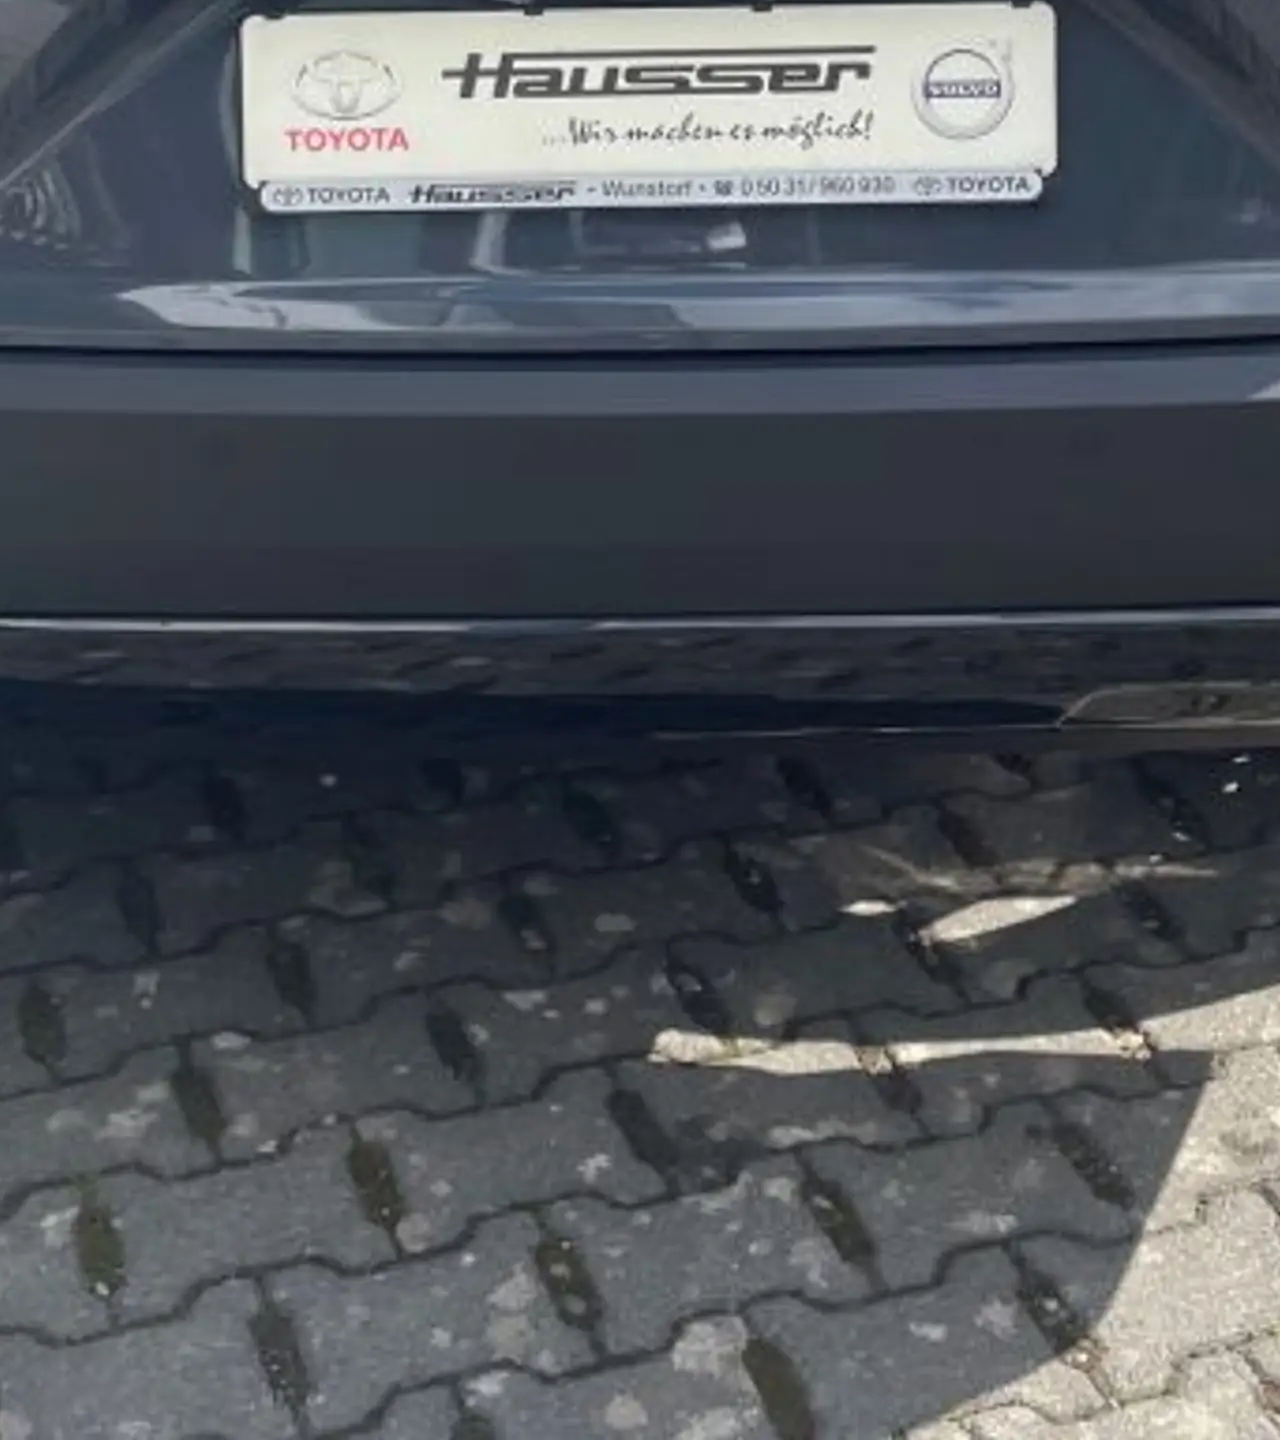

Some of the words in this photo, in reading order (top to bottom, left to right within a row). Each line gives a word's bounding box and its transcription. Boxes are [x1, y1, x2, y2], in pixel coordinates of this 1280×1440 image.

[441, 44, 876, 99] Hausser
[928, 81, 999, 97] VOLVO
[284, 127, 410, 152] TOYOTA
[627, 111, 721, 142] machen
[762, 109, 875, 151] möglich!
[306, 184, 390, 204] TOYOTA
[948, 176, 1030, 194] TOYOTA
